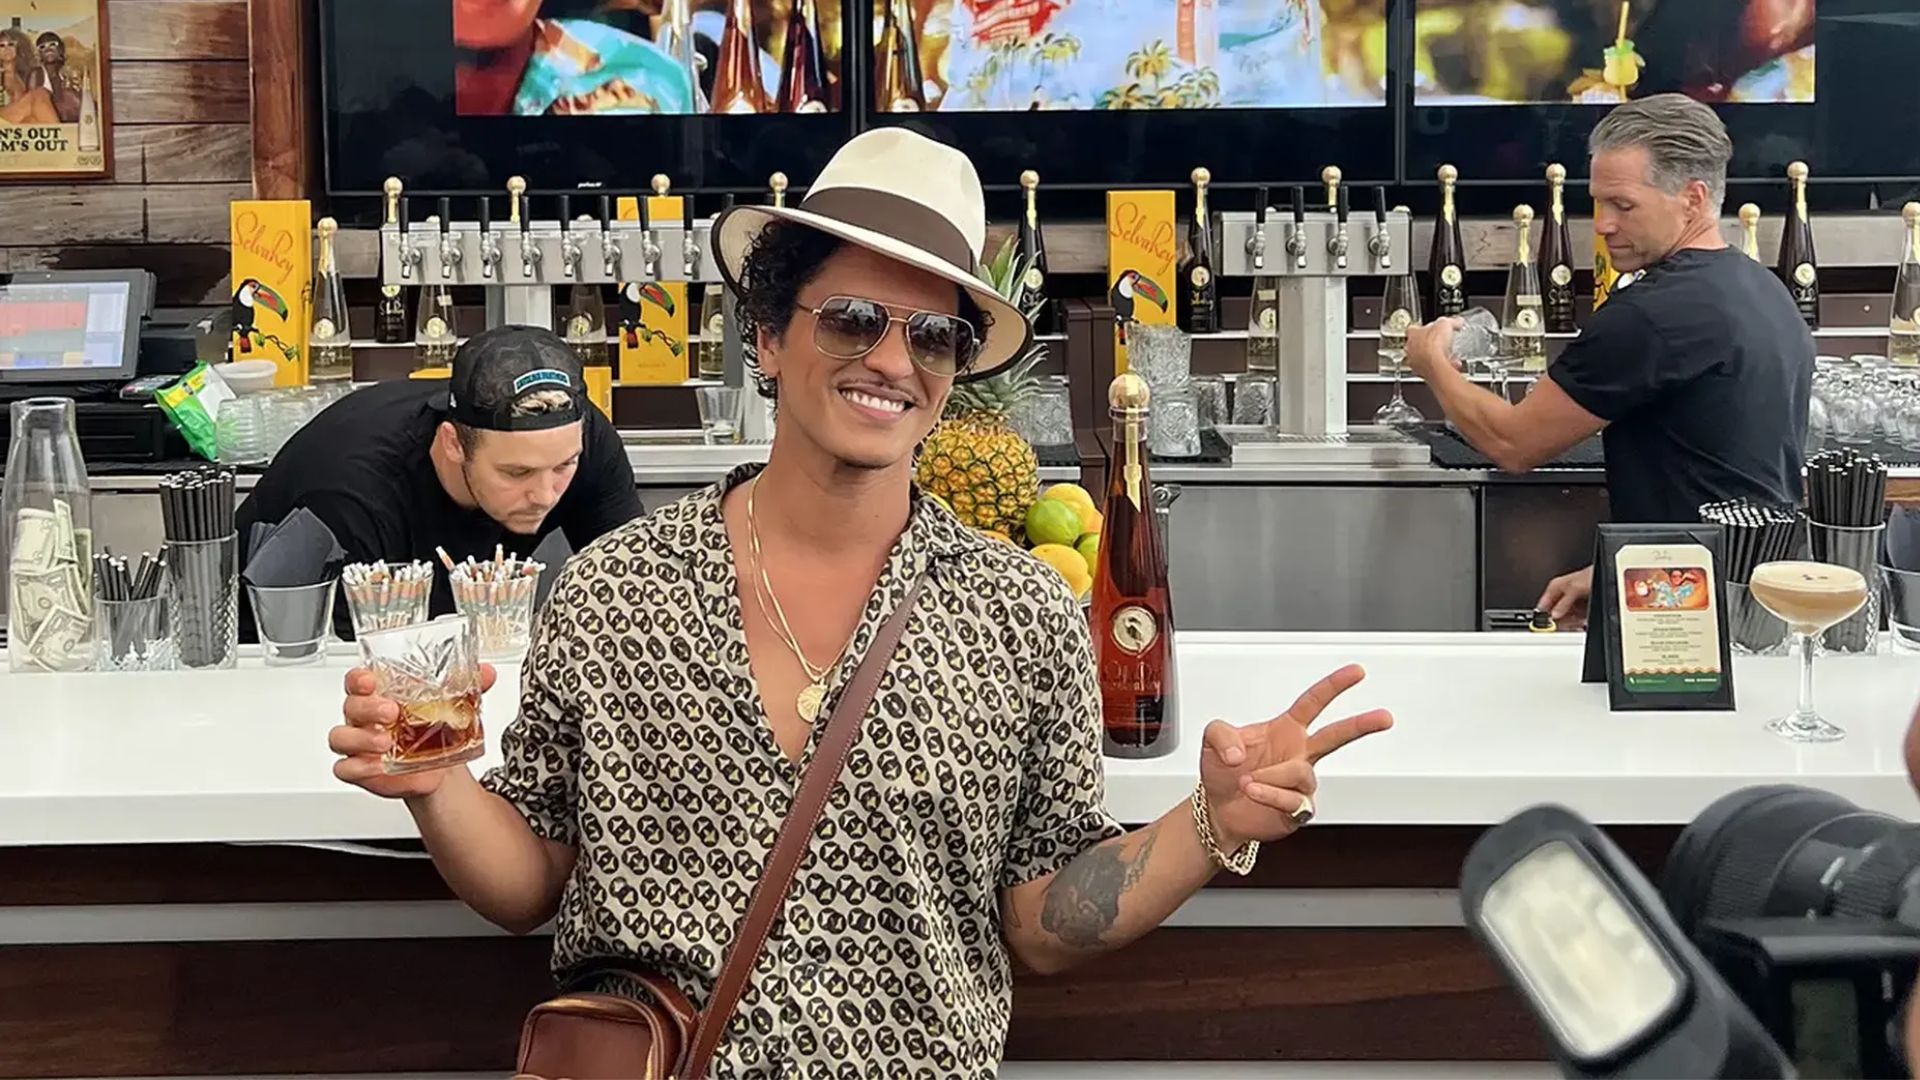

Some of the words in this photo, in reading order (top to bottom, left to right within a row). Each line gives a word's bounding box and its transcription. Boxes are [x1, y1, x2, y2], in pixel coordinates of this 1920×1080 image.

[27, 127, 61, 139] OUT
[34, 139, 68, 151] OUT
[1109, 201, 1175, 276] SelvaRey
